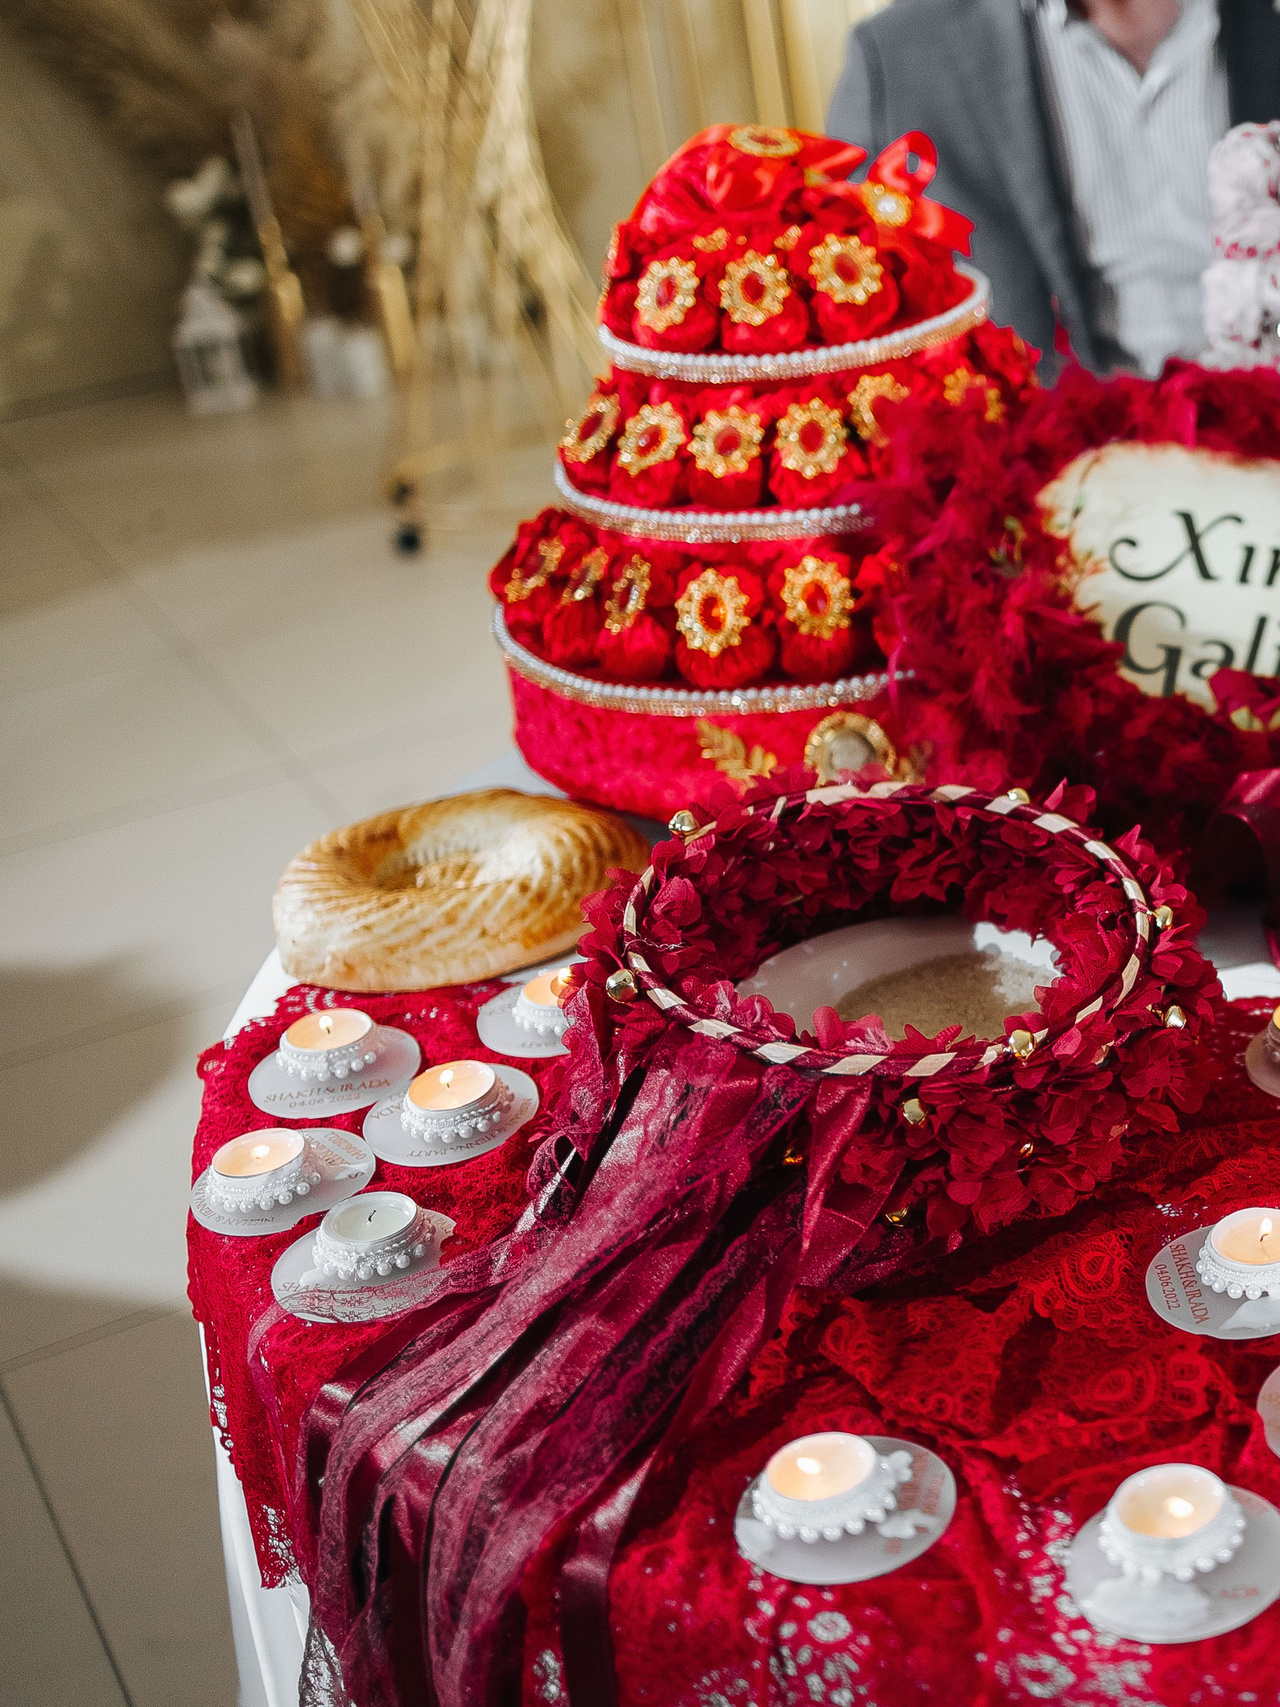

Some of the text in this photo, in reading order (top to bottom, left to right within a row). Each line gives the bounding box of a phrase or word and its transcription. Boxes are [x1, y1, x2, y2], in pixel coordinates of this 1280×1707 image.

[1154, 1263, 1181, 1311] 04.06.2022
[1169, 1243, 1196, 1280] SHAKH
[1184, 1288, 1210, 1325] IRADA
